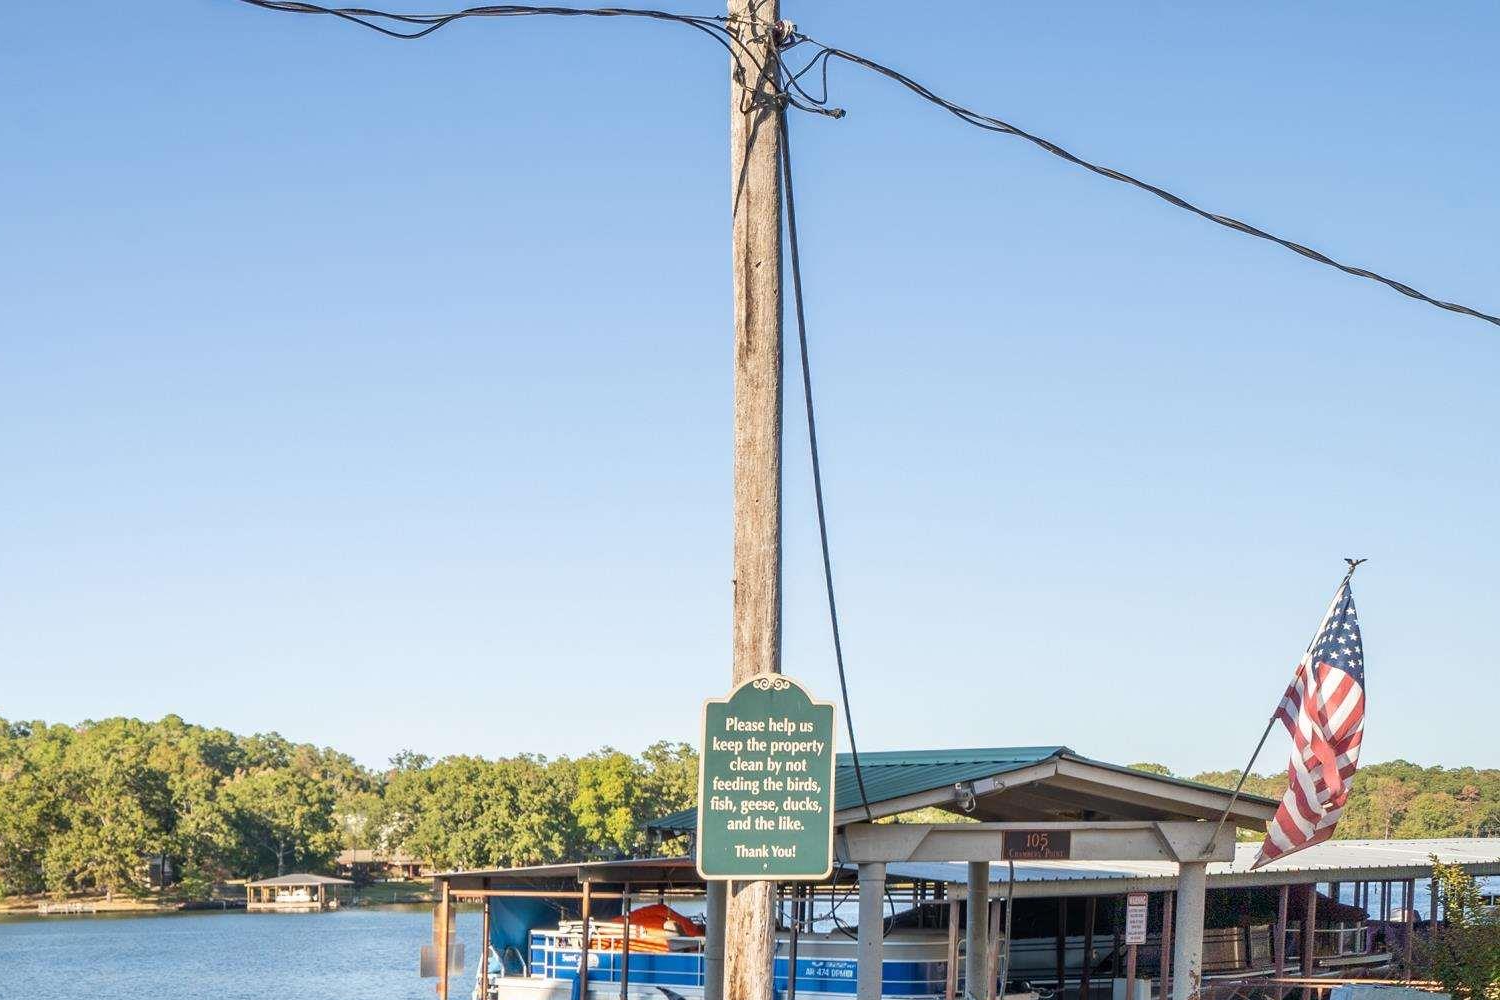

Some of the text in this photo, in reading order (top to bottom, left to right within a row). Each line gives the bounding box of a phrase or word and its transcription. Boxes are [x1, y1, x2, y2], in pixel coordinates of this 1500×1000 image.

[725, 717, 814, 736] Please help us
[712, 737, 824, 756] keep the property
[729, 757, 807, 775] clean by not
[712, 776, 821, 794] feeding the birds,
[710, 796, 823, 814] fish, geese, ducks,
[727, 816, 805, 831] and the like.
[1027, 833, 1048, 848] 105
[734, 844, 796, 858] Thank You!
